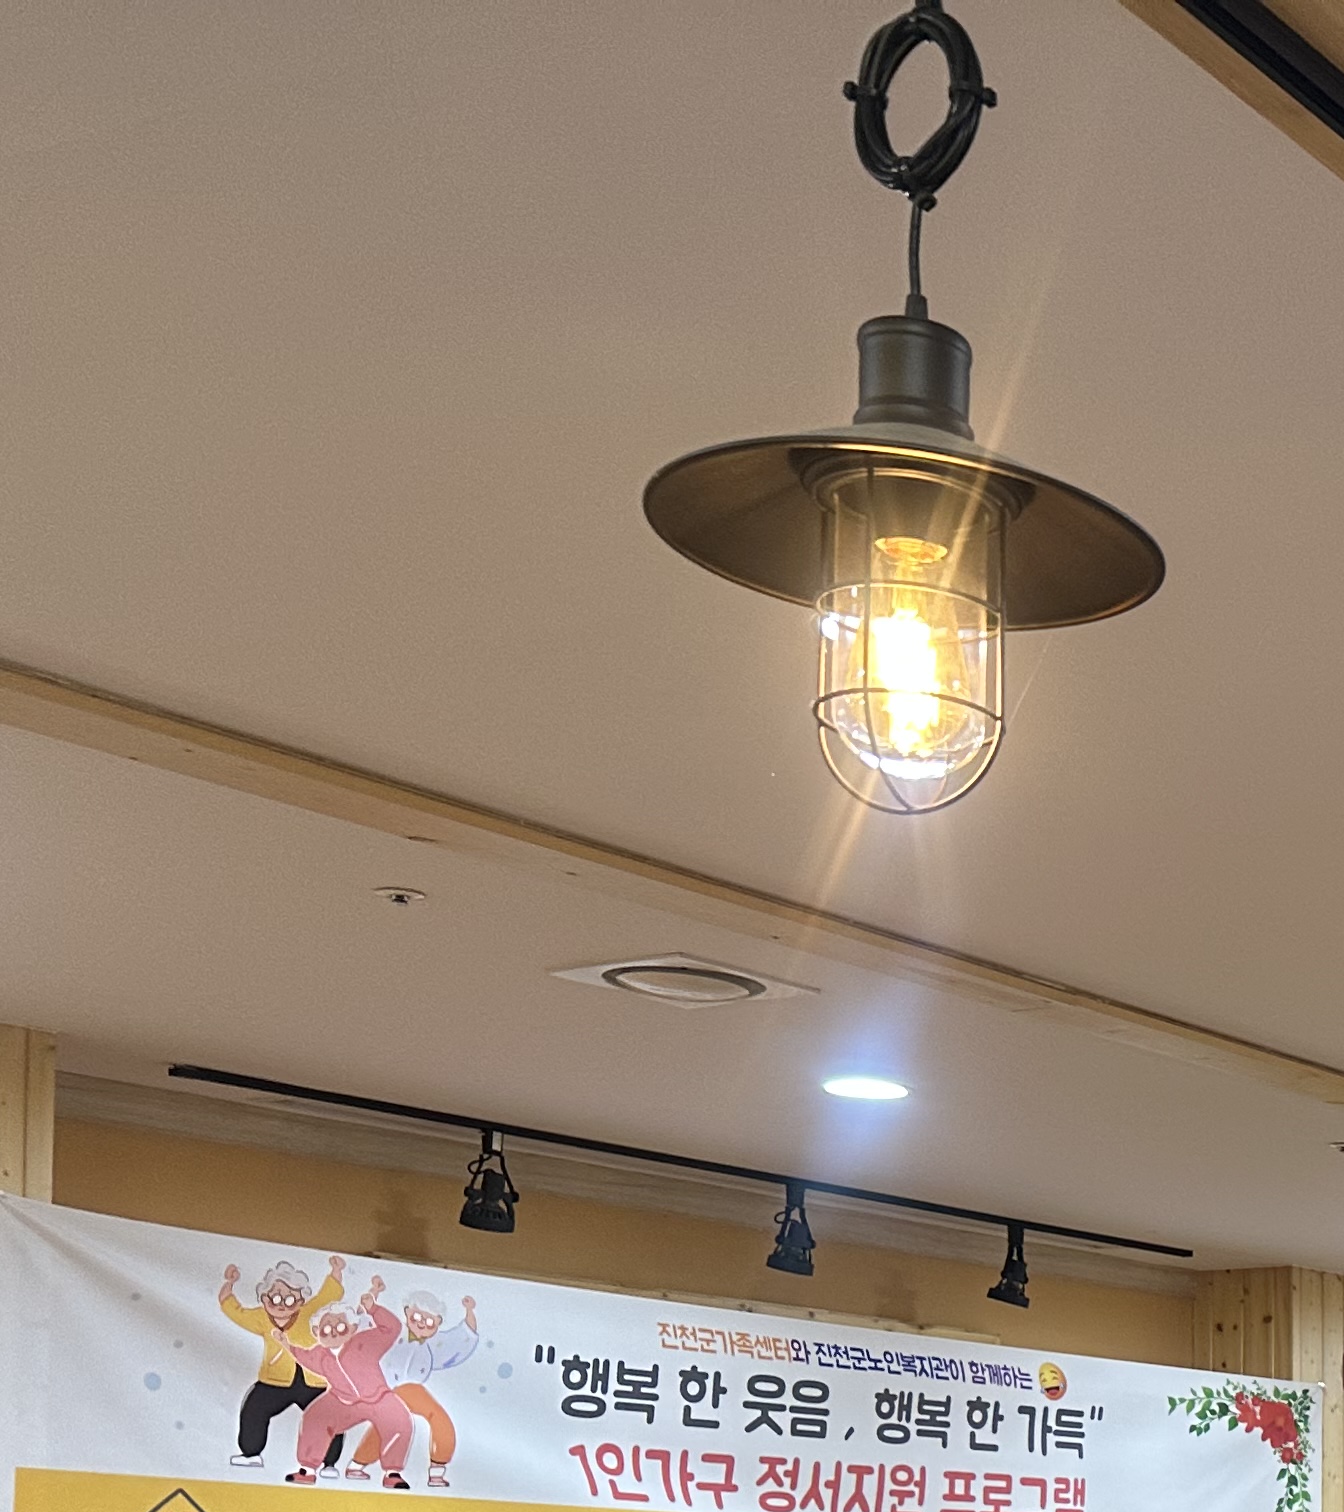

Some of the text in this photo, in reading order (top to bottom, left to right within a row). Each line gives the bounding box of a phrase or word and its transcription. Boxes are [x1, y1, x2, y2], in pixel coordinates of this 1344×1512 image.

[656, 1321, 1033, 1391] 진천군가족센터와 진천군노인복지관이 함께하는
[678, 1365, 727, 1429] 한
[874, 1388, 952, 1449] 행복
[966, 1396, 1005, 1452] 한
[568, 1442, 739, 1510] 1인가구
